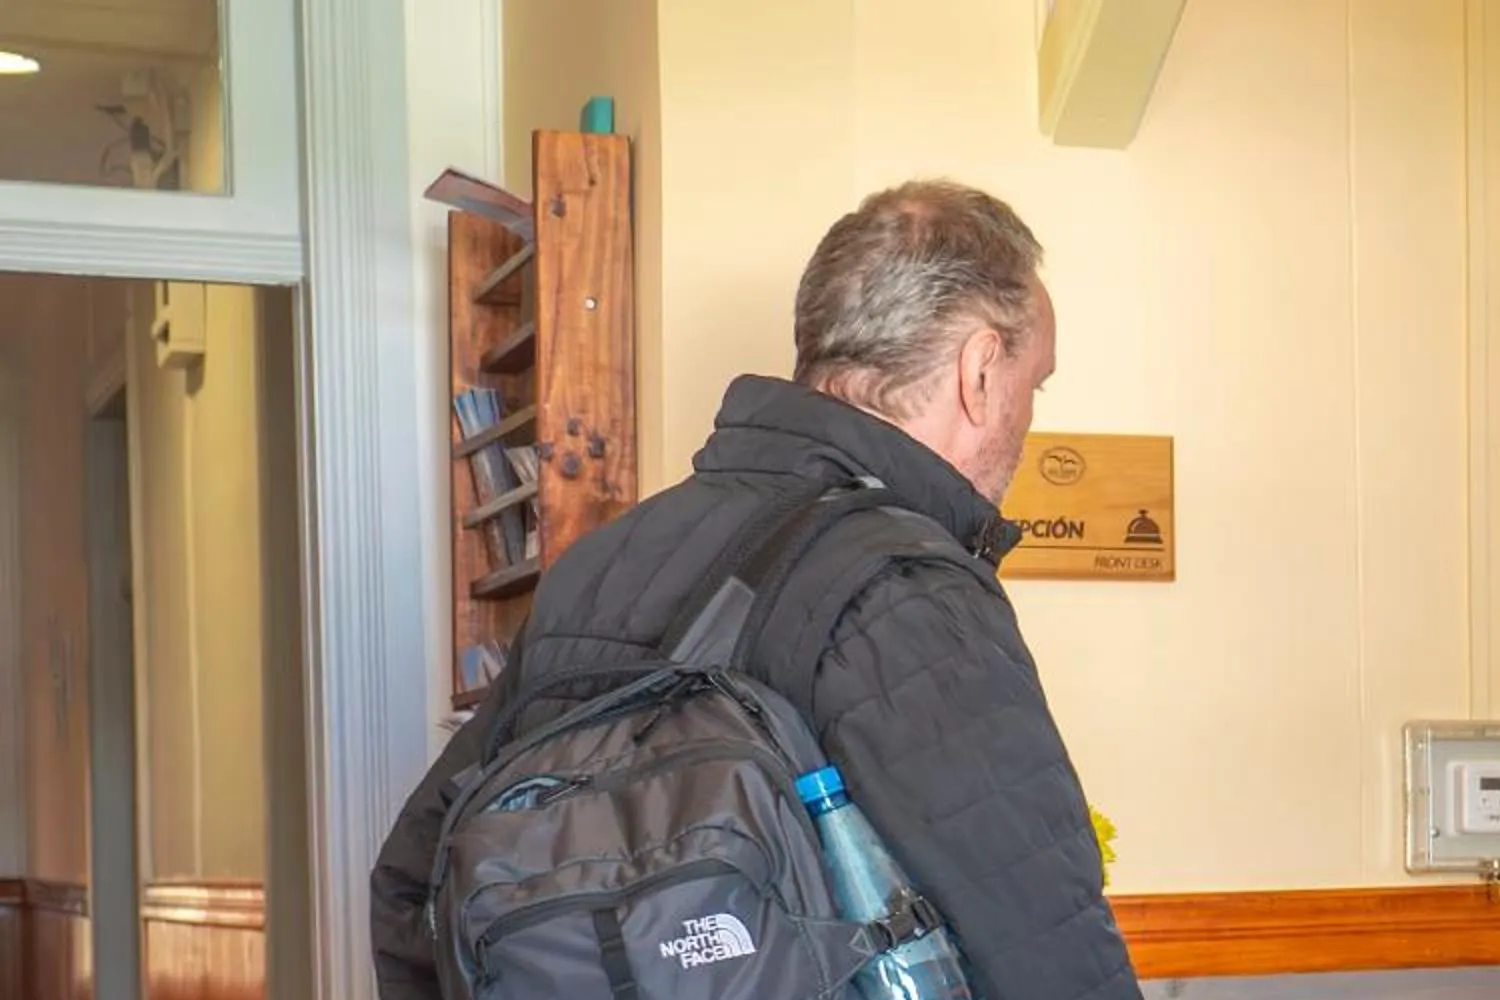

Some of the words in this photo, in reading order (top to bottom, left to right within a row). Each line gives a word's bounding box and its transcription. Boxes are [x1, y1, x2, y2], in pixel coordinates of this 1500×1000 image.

[1013, 516, 1085, 539] PCIÓN
[683, 915, 717, 935] THE
[660, 932, 720, 958] NORTH
[681, 945, 727, 969] FACE
